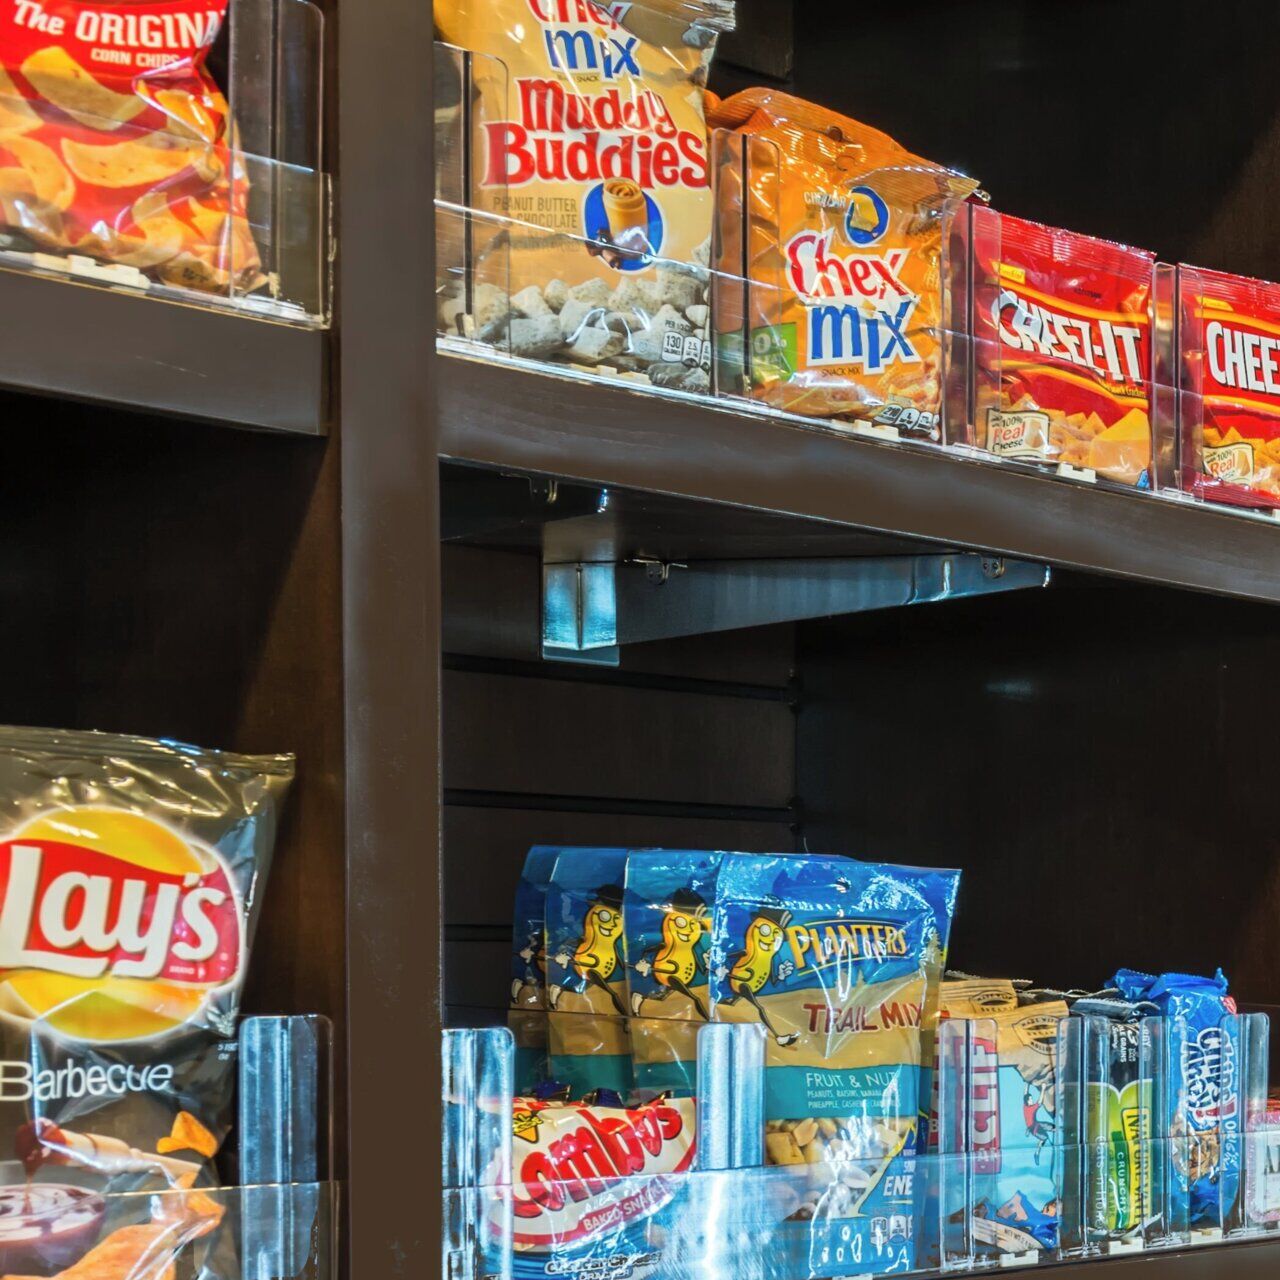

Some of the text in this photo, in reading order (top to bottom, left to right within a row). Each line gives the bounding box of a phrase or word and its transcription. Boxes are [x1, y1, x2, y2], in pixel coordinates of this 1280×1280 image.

[15, 0, 65, 35] The
[91, 48, 131, 65] CORN
[545, 27, 640, 79] mix
[517, 79, 677, 139] Muddy
[480, 123, 709, 188] Buddies
[493, 196, 577, 212] PEANUT BUTTER
[789, 233, 908, 299] Chex
[666, 334, 681, 349] 130
[811, 300, 914, 369] mix
[994, 423, 1025, 441] Real
[1210, 456, 1236, 478] Real
[0, 844, 224, 979] Lay's
[786, 921, 908, 969] PLANTERS
[803, 1001, 878, 1036] TRAIL
[0, 1058, 173, 1103] Barbecue
[806, 1073, 861, 1088] FRUIT &
